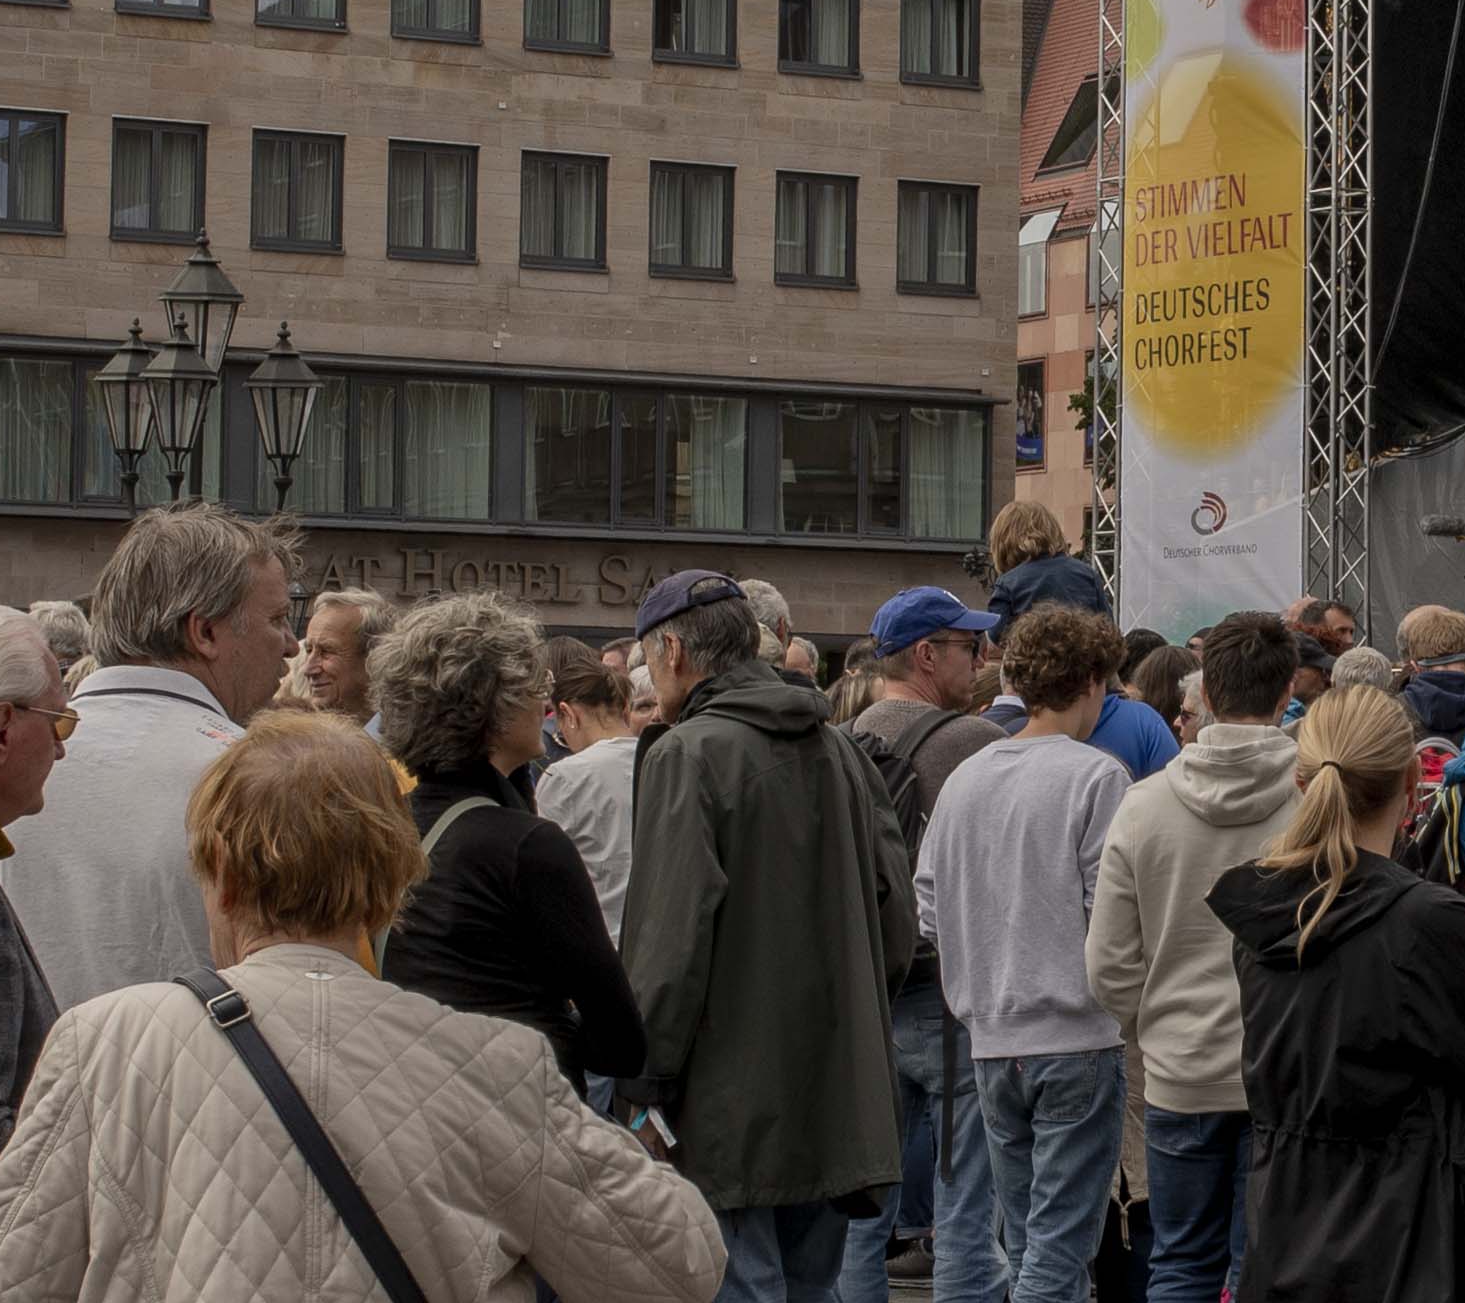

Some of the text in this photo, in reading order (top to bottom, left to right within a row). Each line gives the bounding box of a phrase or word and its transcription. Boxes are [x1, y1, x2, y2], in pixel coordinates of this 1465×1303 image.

[1135, 172, 1246, 223] STIMMEN
[1136, 212, 1293, 267] DER VIELFALT
[1136, 278, 1270, 325] DEUTSCHES
[1135, 327, 1252, 370] CHORFEST
[397, 546, 584, 604] HOTEL
